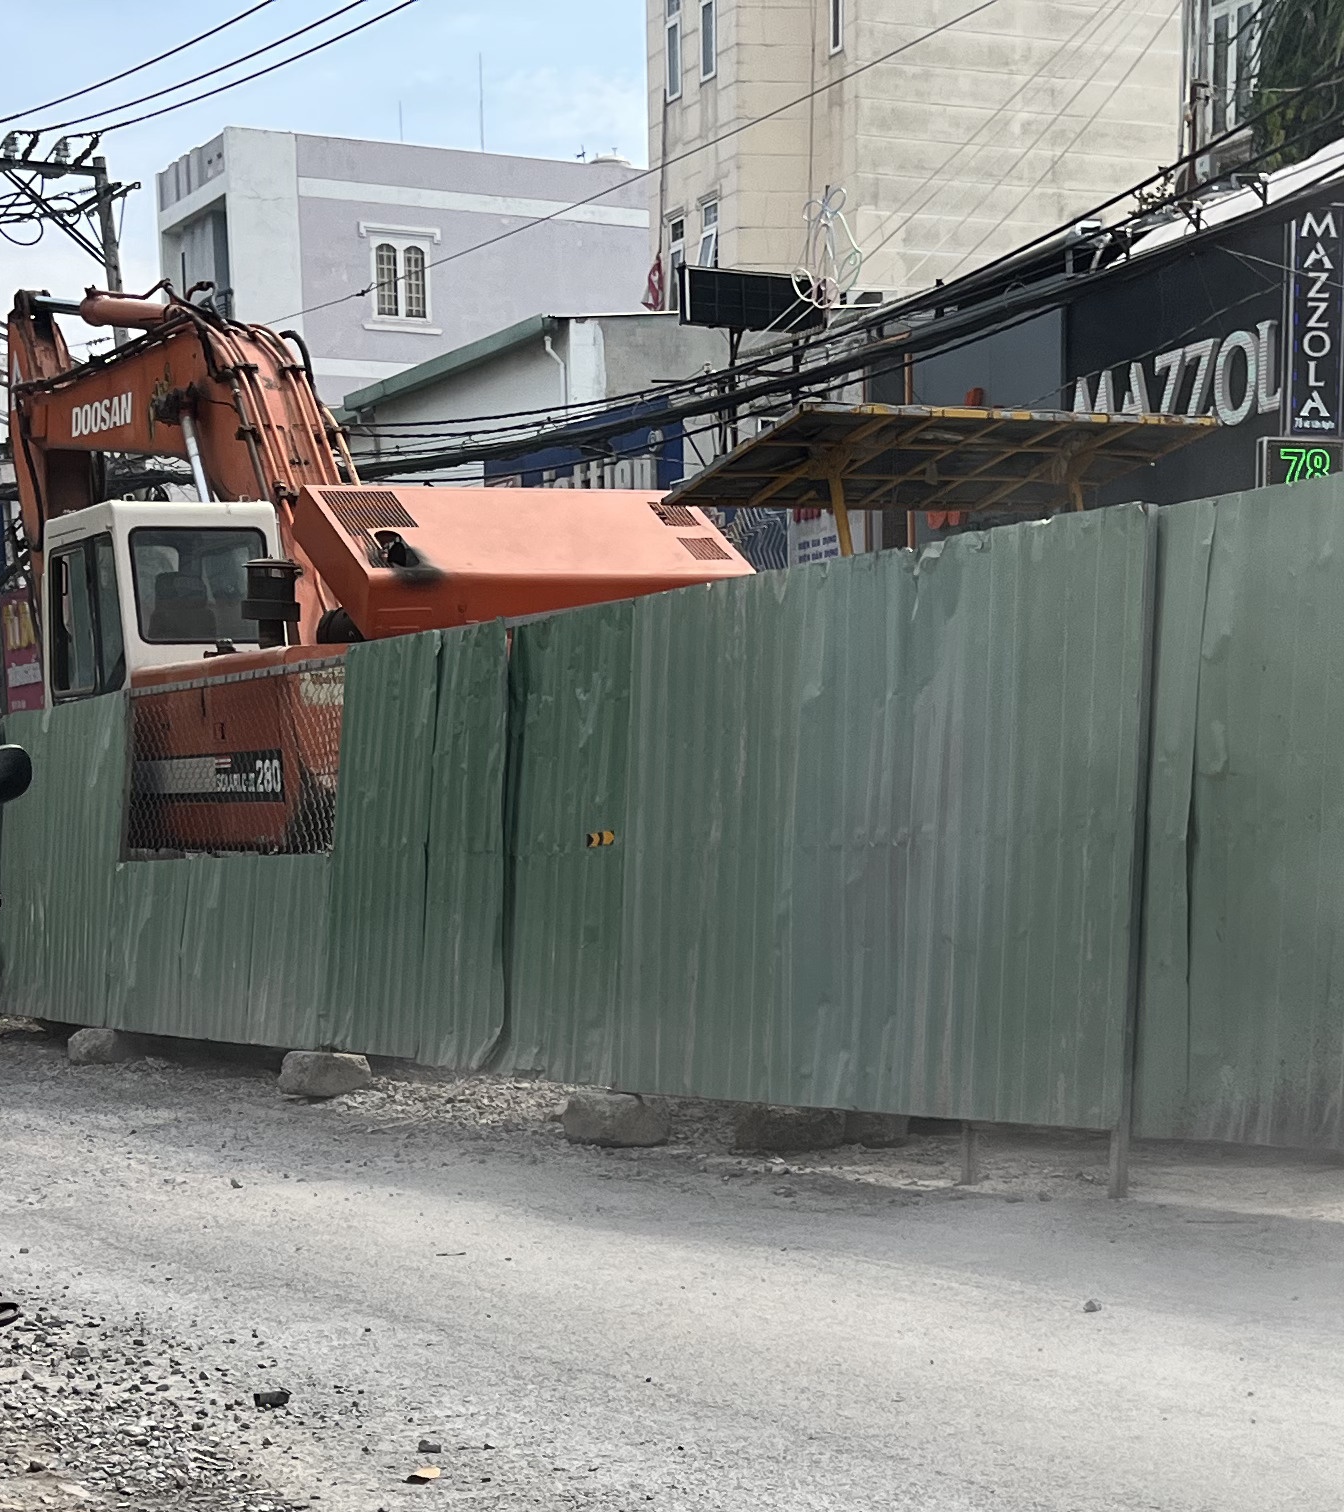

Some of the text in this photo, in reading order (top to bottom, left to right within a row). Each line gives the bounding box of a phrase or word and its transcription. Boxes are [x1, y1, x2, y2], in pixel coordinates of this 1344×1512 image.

[1300, 211, 1339, 417] MAZZOLA
[1073, 320, 1282, 427] MAZZOL
[71, 392, 133, 438] DOOSAN
[256, 759, 282, 793] 280
